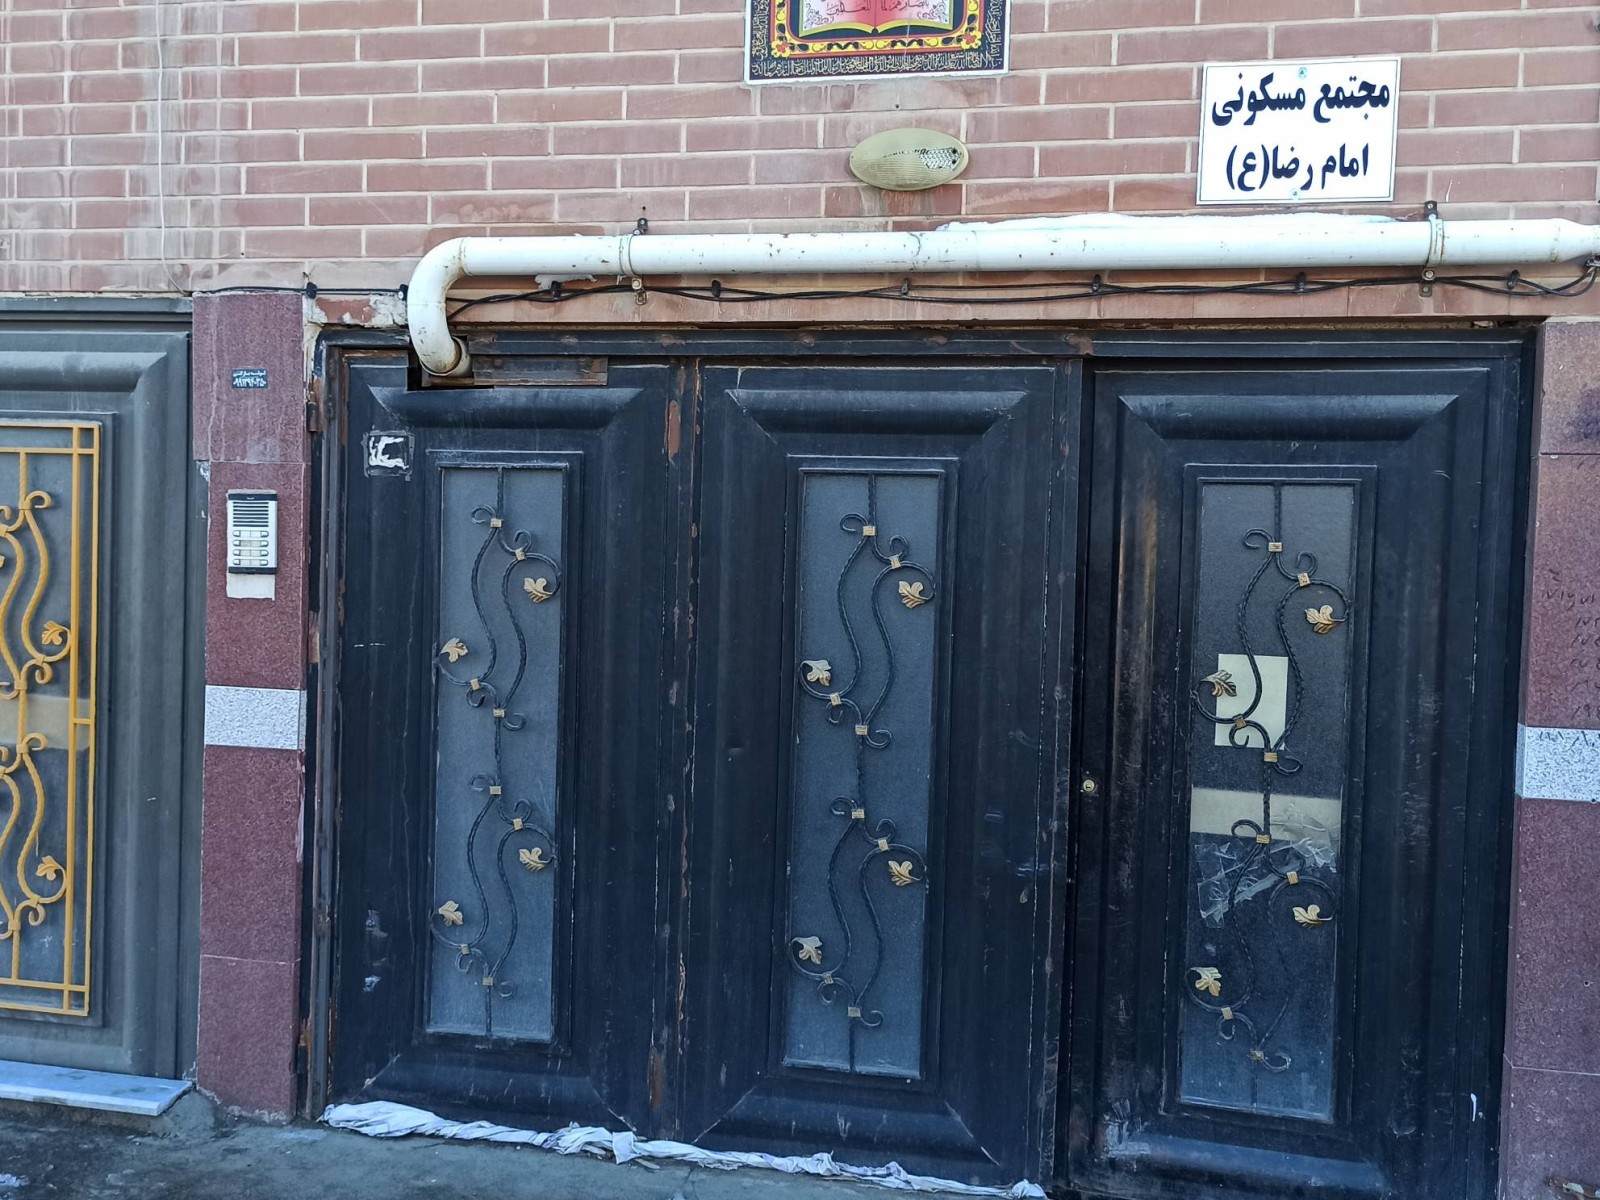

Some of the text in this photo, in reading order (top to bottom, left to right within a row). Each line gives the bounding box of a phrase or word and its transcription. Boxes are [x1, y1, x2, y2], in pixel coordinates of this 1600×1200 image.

[1212, 72, 1390, 126] مجتمع مسکونی
[1321, 143, 1369, 190] امام
